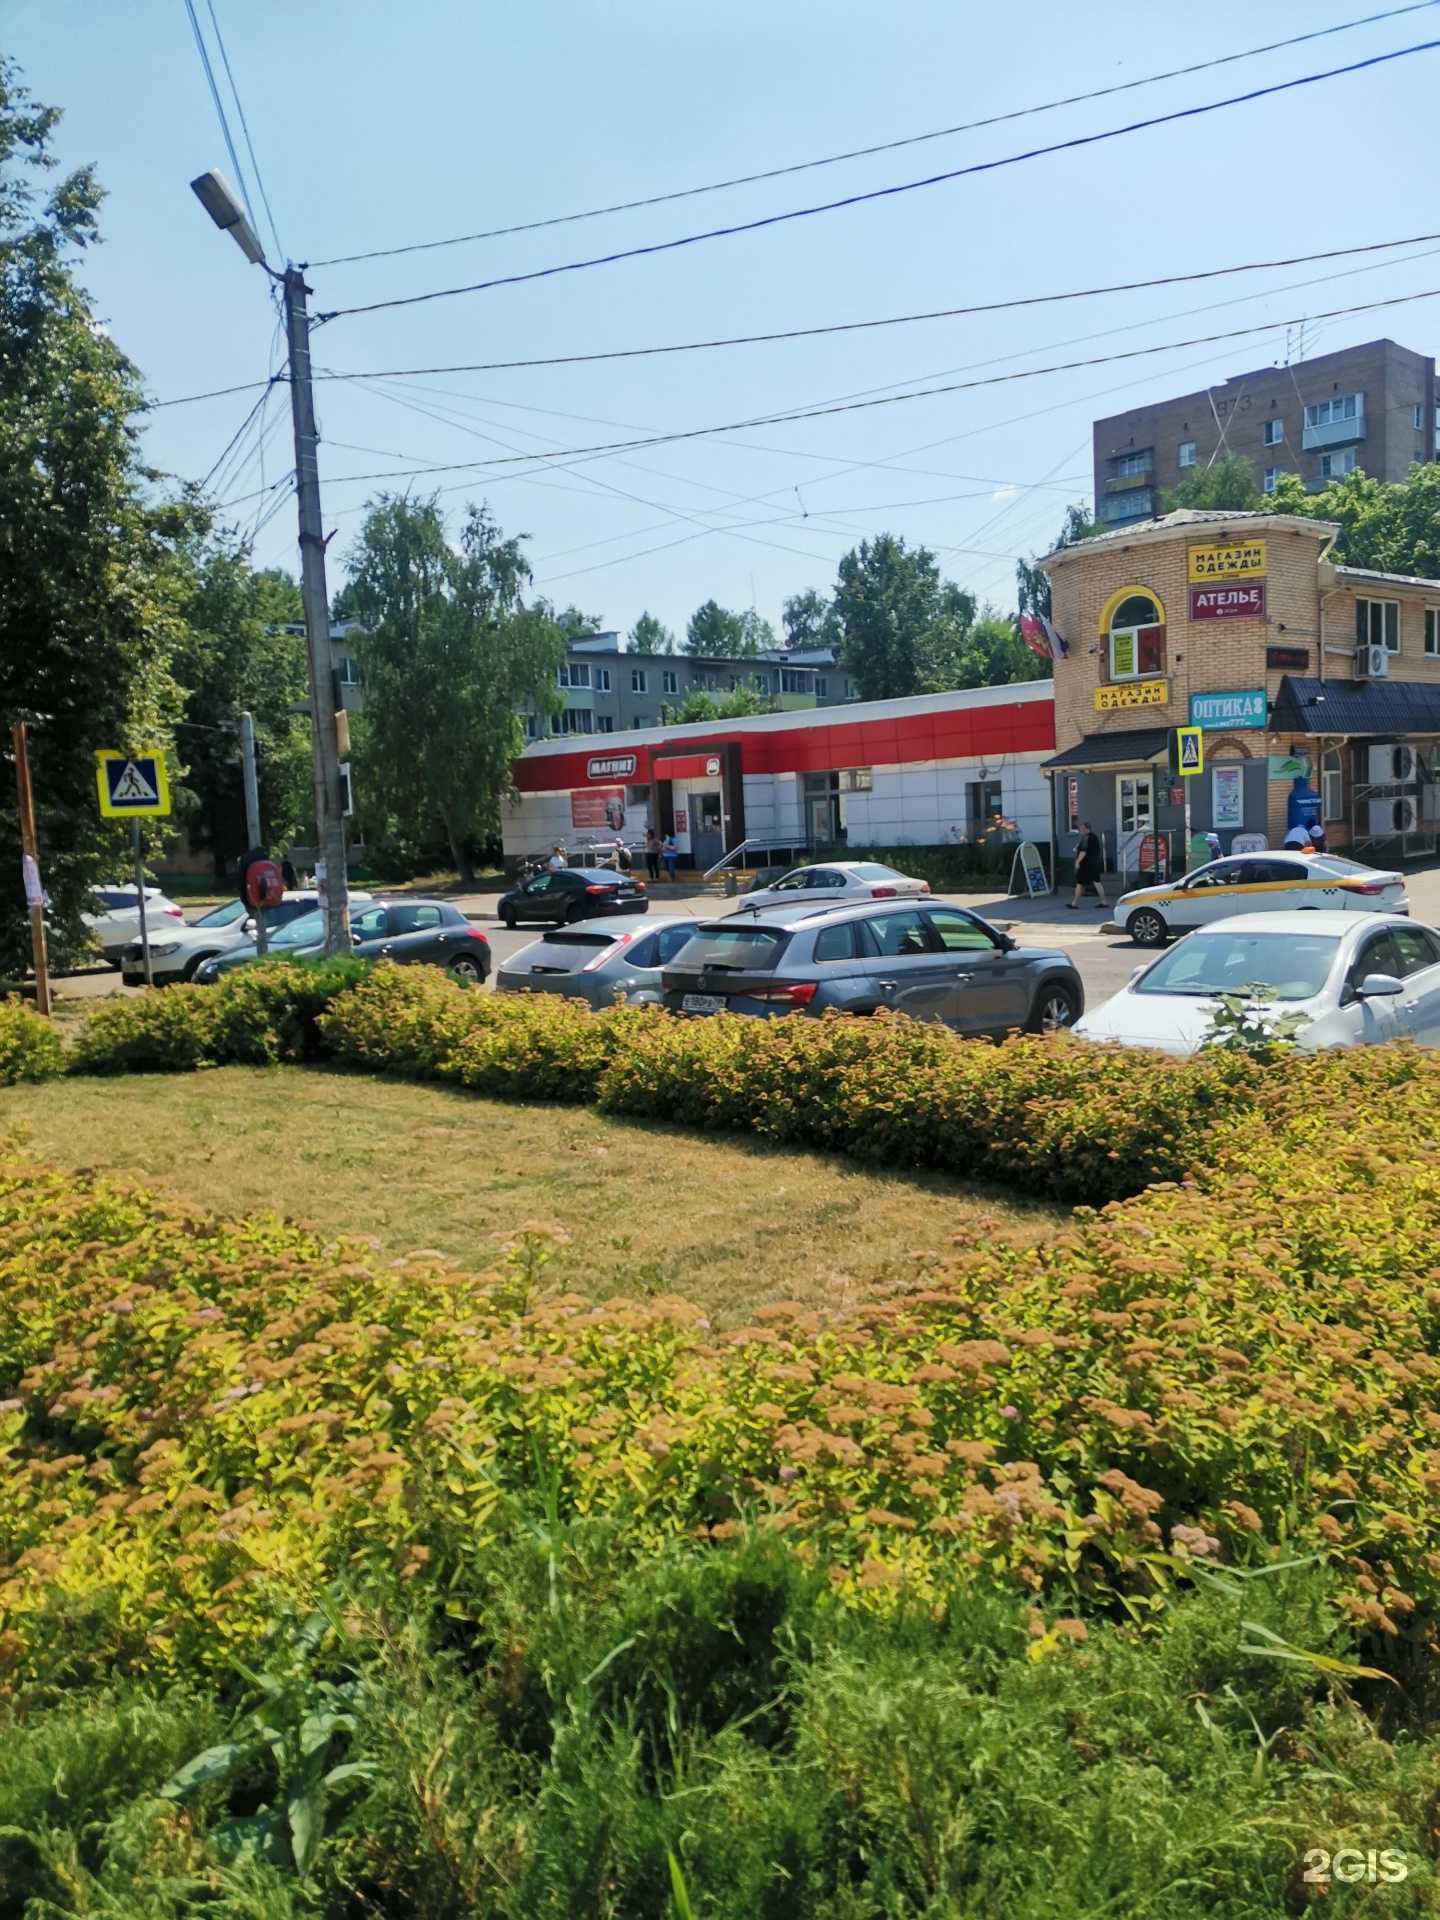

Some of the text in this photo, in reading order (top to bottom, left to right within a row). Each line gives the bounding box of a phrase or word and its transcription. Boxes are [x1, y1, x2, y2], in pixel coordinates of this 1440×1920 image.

[1195, 548, 1261, 563] МАГАЗИН
[1195, 559, 1261, 574] ОДЕЖДЫ
[1196, 589, 1260, 607] АТЕЛЬЕ
[1100, 687, 1160, 700] МАГАЗИН
[1100, 695, 1160, 708] ОДЕЖДЫ
[1193, 697, 1253, 720] ОПТИКА
[590, 759, 633, 775] МАГНИТ
